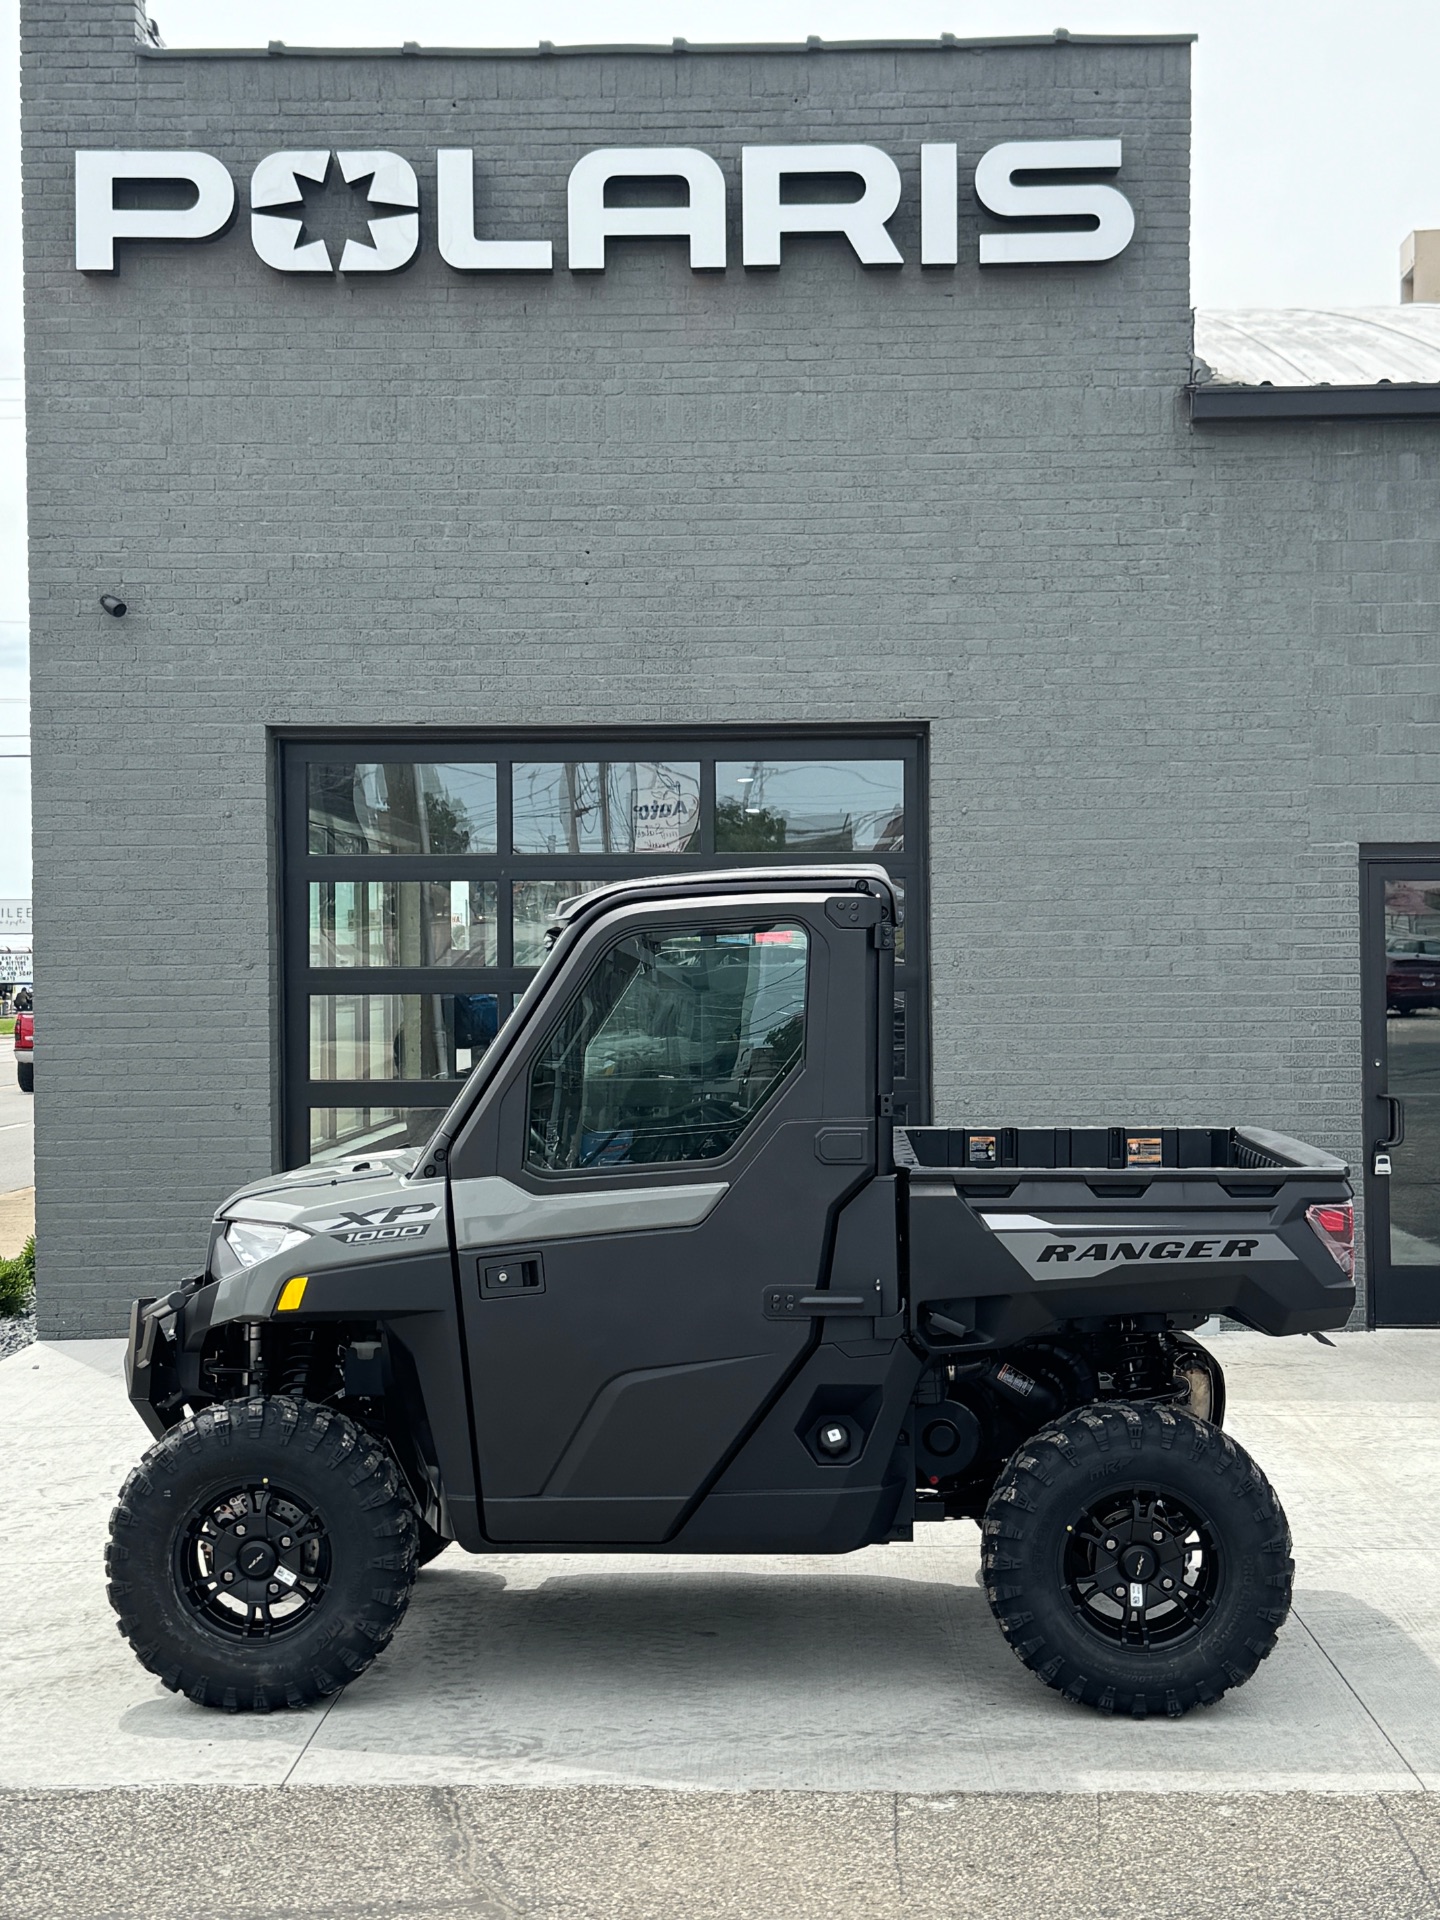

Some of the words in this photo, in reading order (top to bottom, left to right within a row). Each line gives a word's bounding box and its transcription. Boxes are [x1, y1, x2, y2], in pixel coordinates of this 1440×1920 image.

[75, 140, 1136, 272] POLARIS
[325, 1203, 437, 1231] XP
[346, 1226, 424, 1243] 1000
[1036, 1240, 1259, 1263] RANGER
